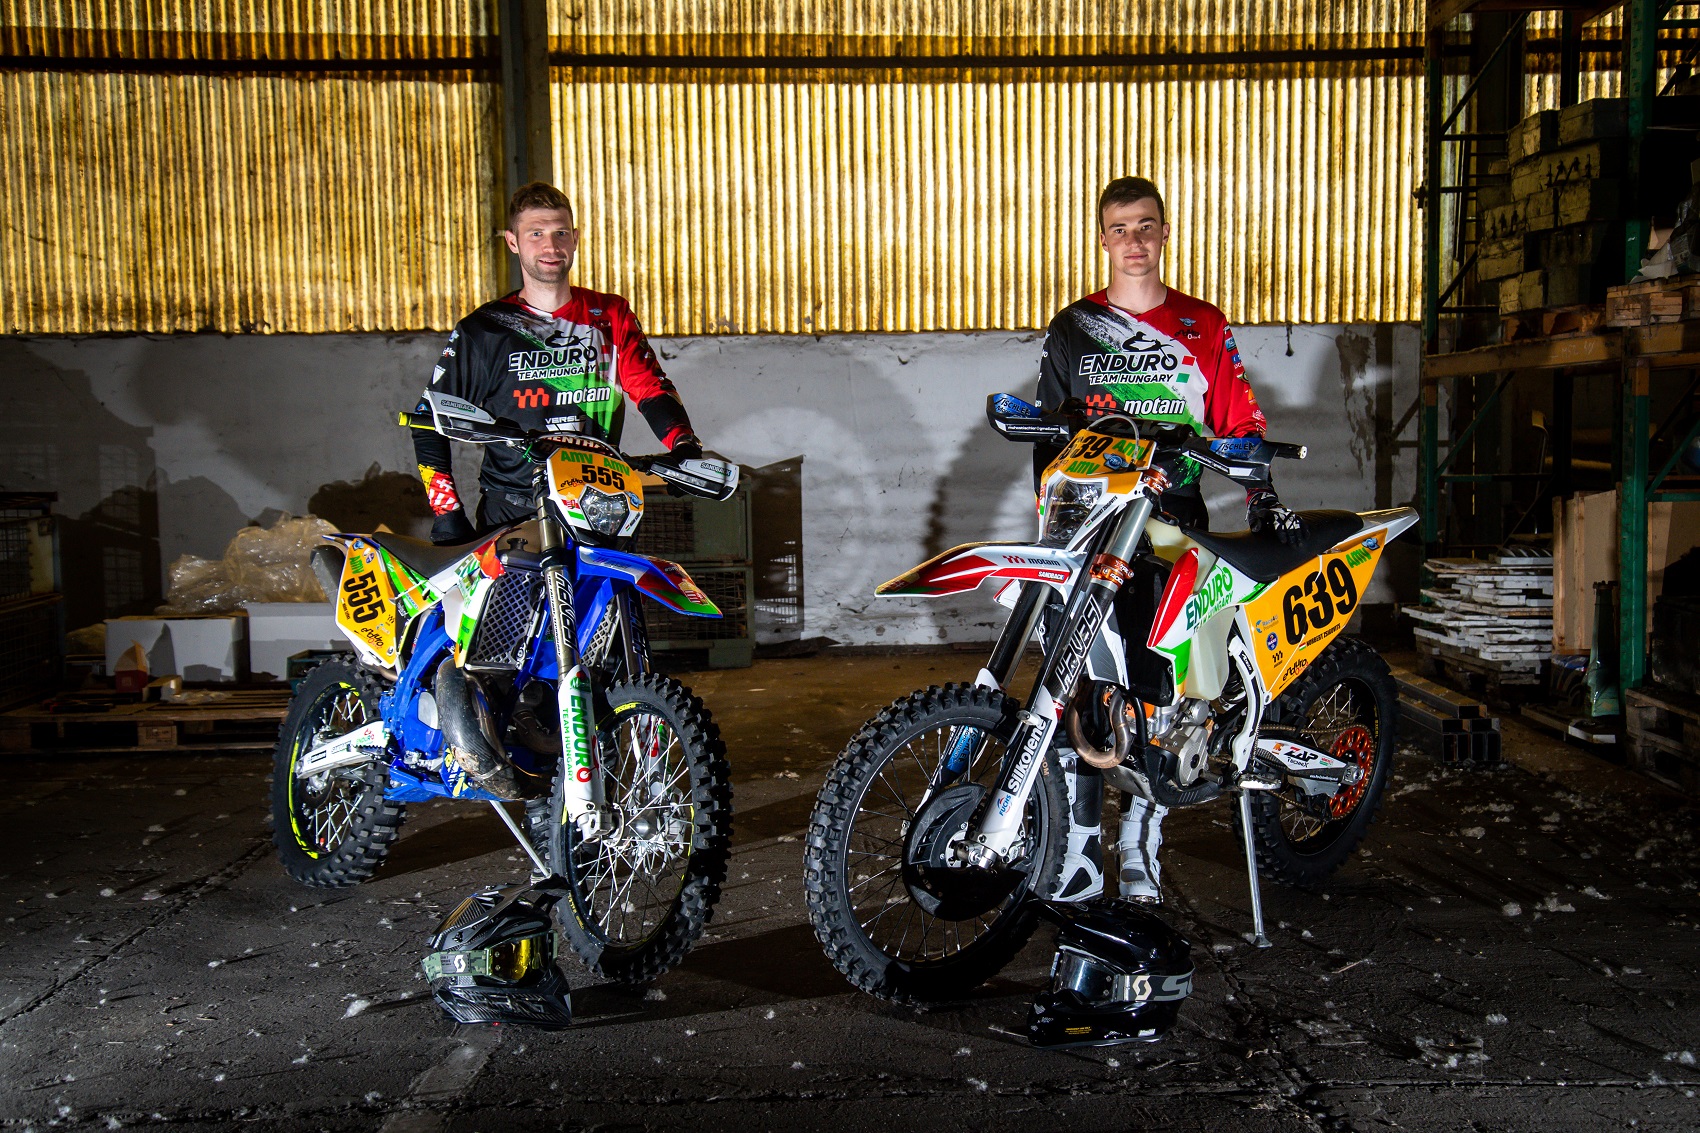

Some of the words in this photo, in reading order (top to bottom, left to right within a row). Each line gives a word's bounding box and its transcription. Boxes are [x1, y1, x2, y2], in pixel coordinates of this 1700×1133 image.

[508, 345, 598, 371] ENDURO
[1079, 353, 1178, 375] ENDURO
[518, 370, 548, 381] TEAM
[549, 364, 596, 378] HUNGARY
[1089, 373, 1119, 385] TEAM
[1119, 373, 1173, 384] HUNGARY
[556, 387, 611, 406] motam
[1123, 396, 1186, 416] motam
[581, 464, 625, 490] 555
[1028, 557, 1061, 566] motam
[343, 570, 386, 624] 555
[1186, 567, 1233, 631] ENDURO
[1282, 558, 1358, 645] 639
[562, 708, 570, 734] TEAM
[571, 695, 592, 783] ENDURO
[564, 734, 574, 782] HUNGARY
[1007, 719, 1047, 793] Silkolene
[999, 794, 1012, 817] FUCHS
